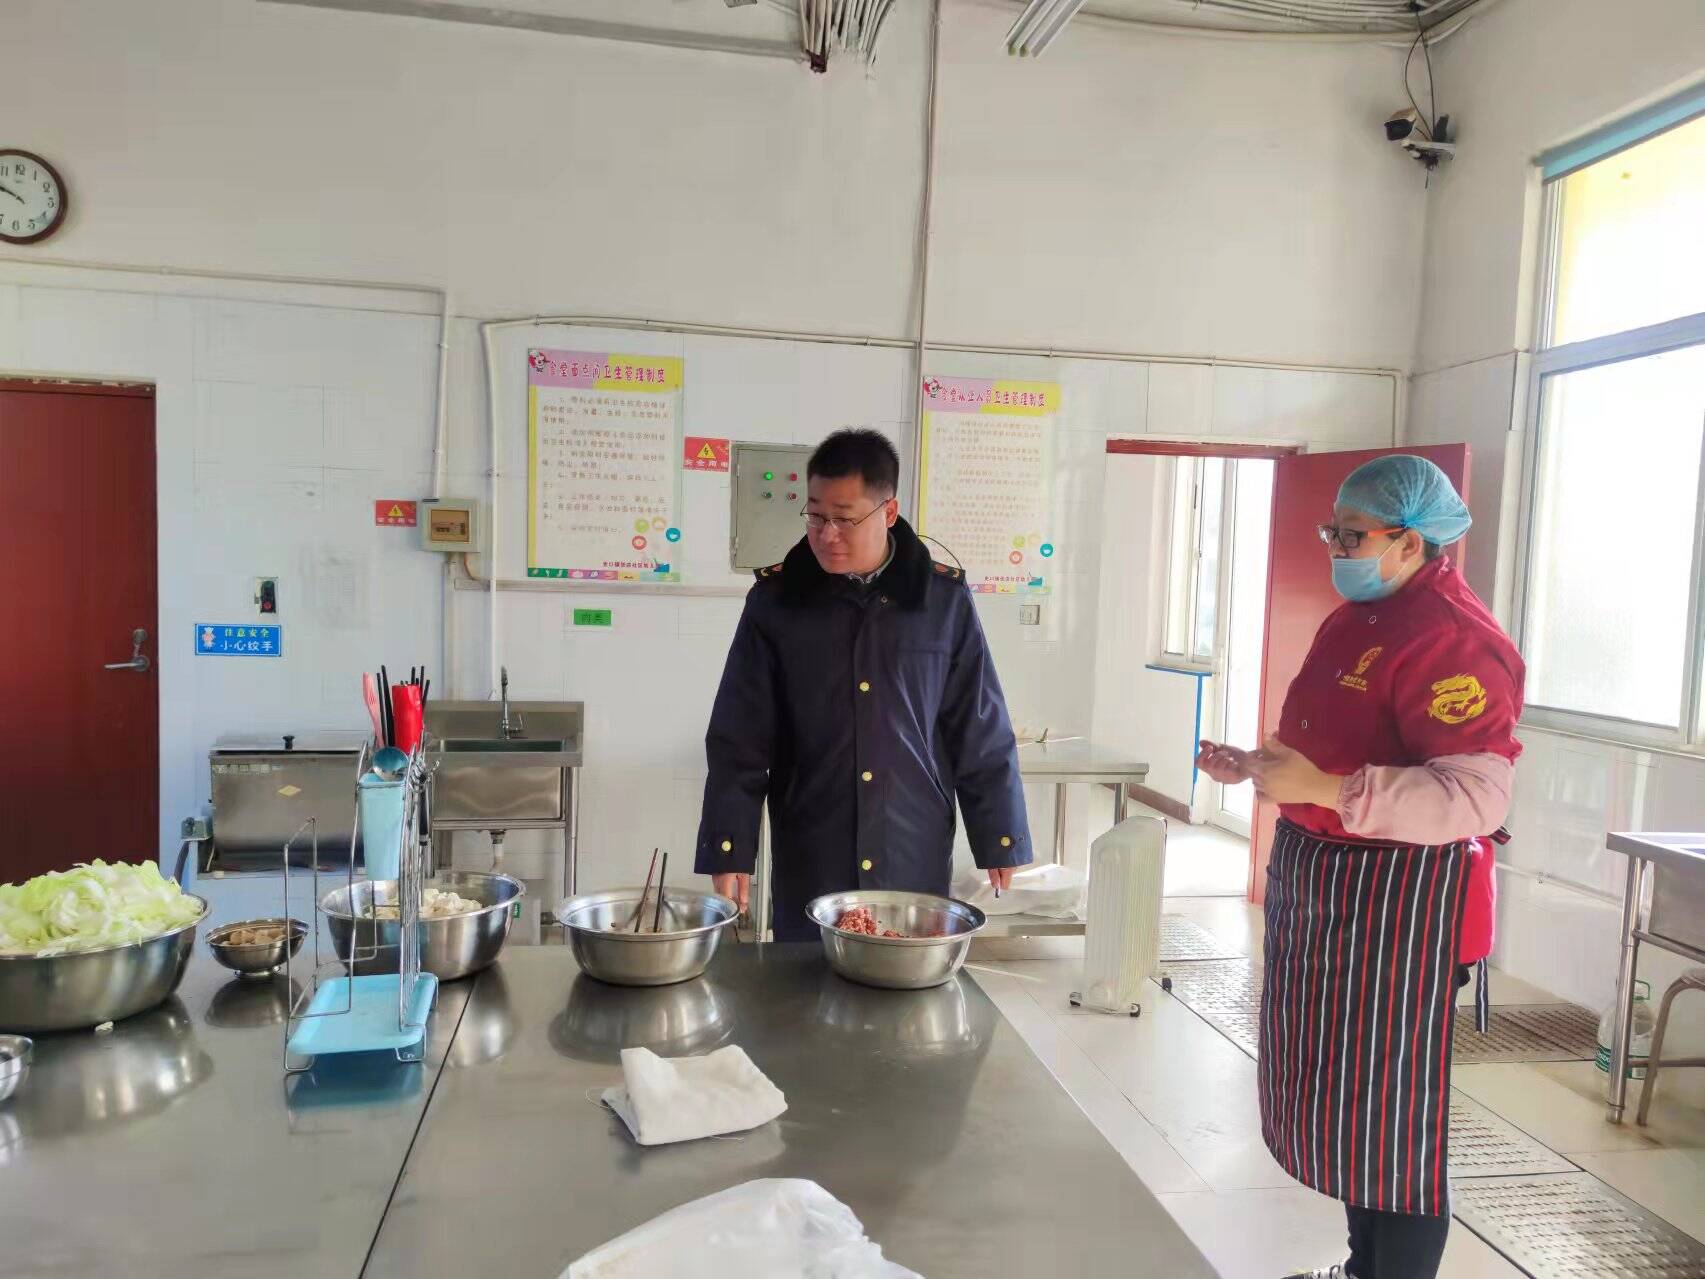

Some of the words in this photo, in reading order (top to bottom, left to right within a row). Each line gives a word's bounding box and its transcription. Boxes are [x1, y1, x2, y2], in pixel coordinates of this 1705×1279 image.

[15, 164, 26, 176] 12
[42, 182, 51, 193] 2
[47, 197, 55, 209] 3
[11, 220, 20, 231] 6
[28, 219, 36, 230] 5
[224, 628, 270, 638] 注意安全
[220, 640, 273, 652] 小心绞手
